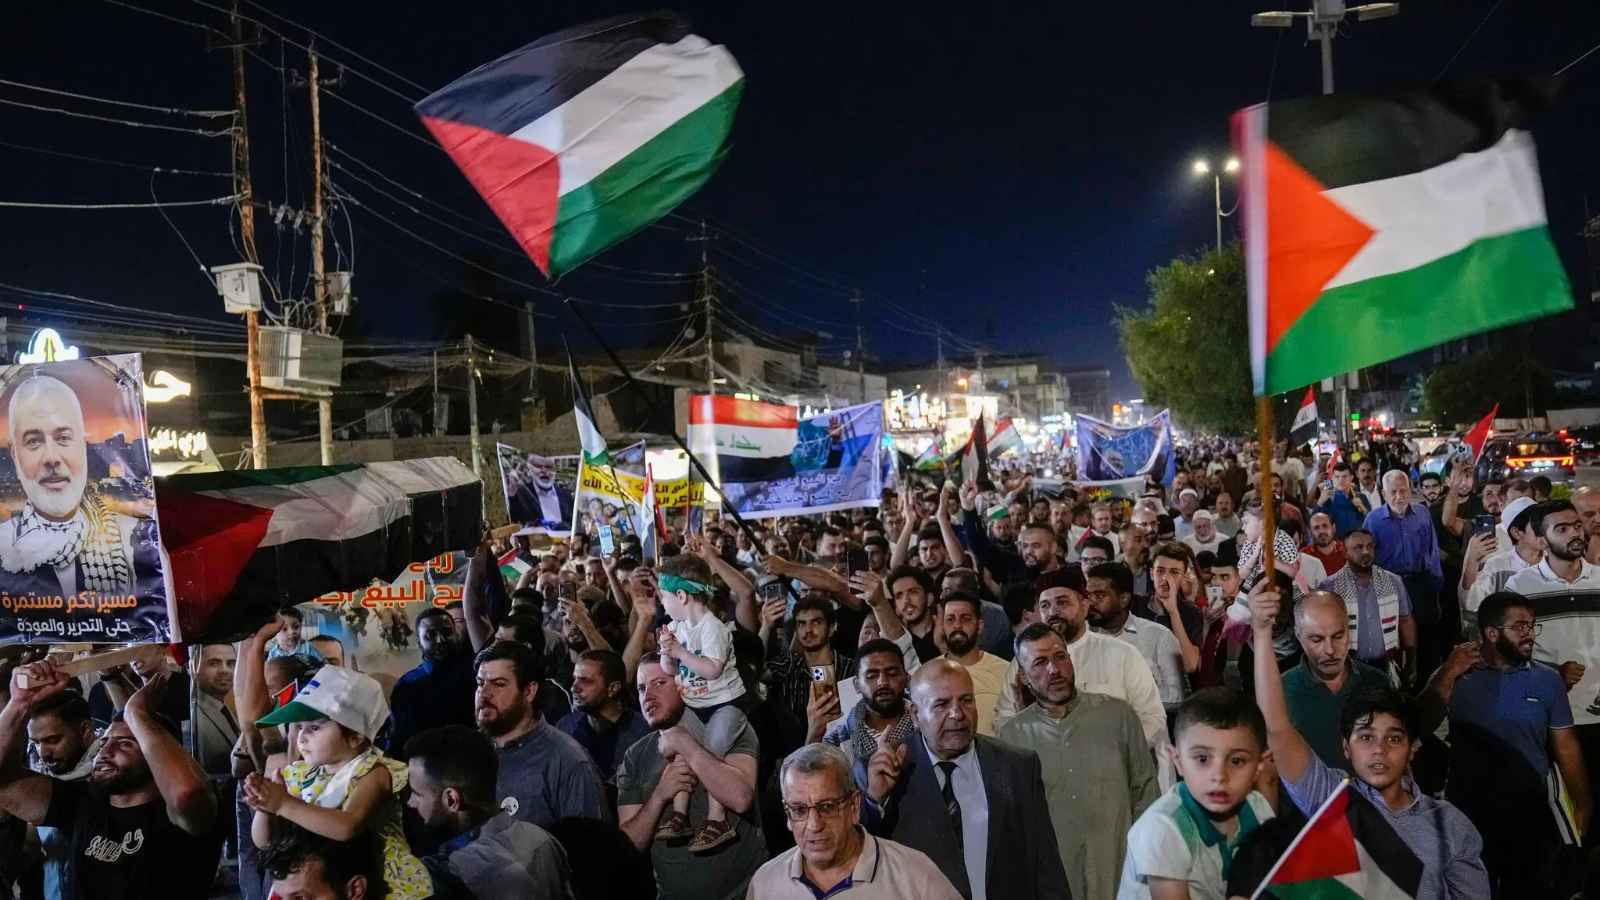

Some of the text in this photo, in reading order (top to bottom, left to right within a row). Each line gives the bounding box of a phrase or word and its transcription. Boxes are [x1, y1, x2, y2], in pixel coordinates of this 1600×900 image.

[1, 590, 138, 613] مسيرتكم مستمرة
[361, 580, 425, 608] البيع
[17, 618, 131, 637] حتى التحرير والعودة
